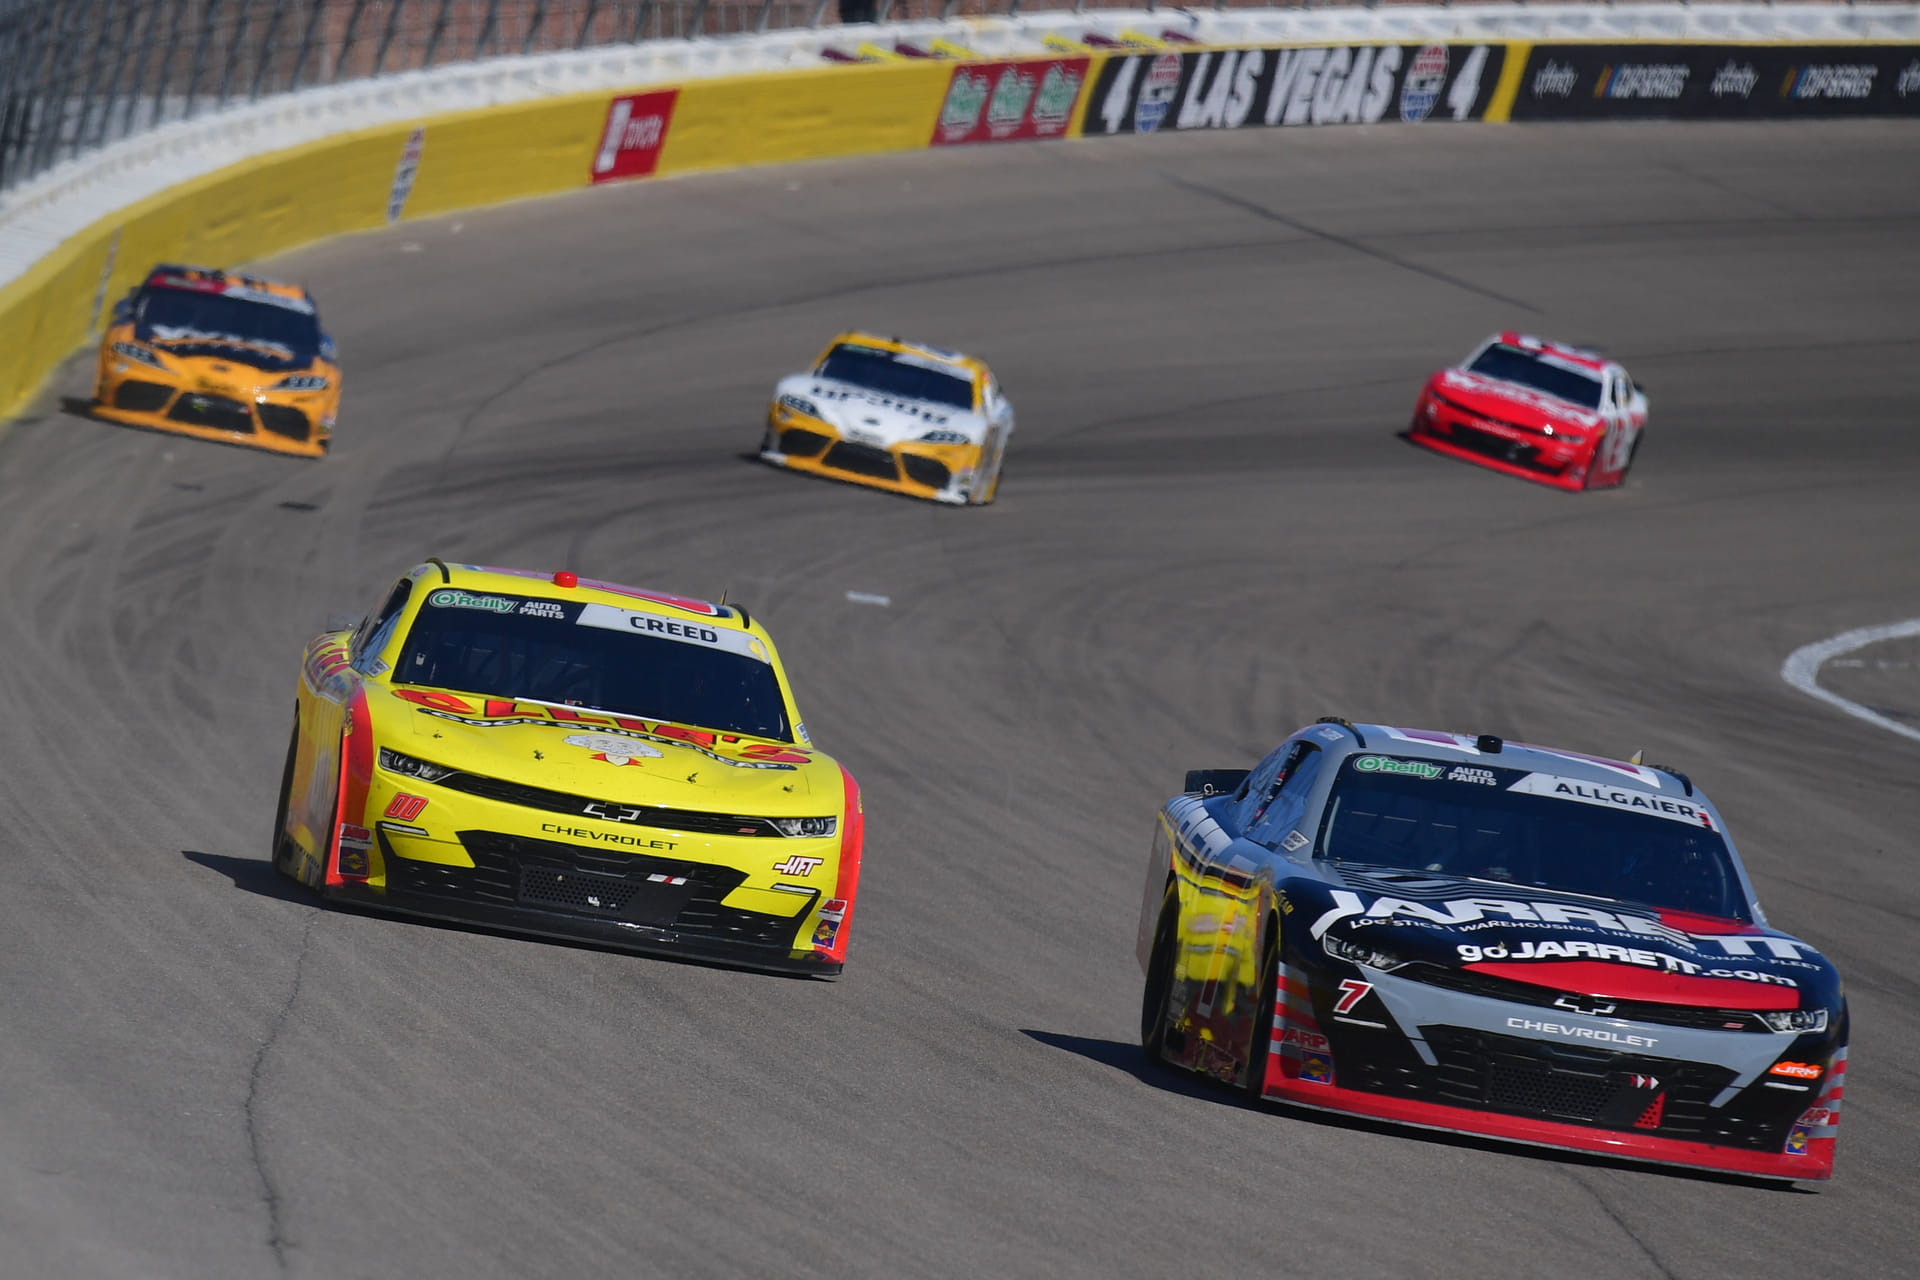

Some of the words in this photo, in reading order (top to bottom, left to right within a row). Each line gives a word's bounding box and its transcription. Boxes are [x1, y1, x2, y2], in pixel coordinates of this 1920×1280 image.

[1102, 55, 1140, 134] 4
[1177, 50, 1265, 129] LAS
[1265, 46, 1402, 126] VEGAS
[1447, 46, 1490, 122] 4
[432, 590, 514, 612] O'Reilly
[519, 607, 565, 619] PARTS
[525, 601, 562, 611] AUTO
[630, 616, 718, 643] CREED
[1356, 756, 1441, 777] O'Reilly
[1448, 772, 1497, 786] PARTS
[1454, 766, 1494, 778] AUTO
[384, 792, 429, 821] 00
[1555, 782, 1697, 819] ALLGAIER
[542, 824, 678, 850] CHEVROLET
[1310, 889, 1821, 959] JARRETT
[1350, 917, 1443, 931] LOGSTICS
[1459, 920, 1595, 933] WAREHOUSING
[1612, 931, 1753, 961] INTERNATIONAL
[1769, 959, 1823, 972] FLEET
[1457, 941, 1798, 987] goJARRETT.com
[1333, 978, 1374, 1015] 7
[1285, 1028, 1328, 1048] ARP
[1507, 1017, 1659, 1048] CHEVROLET
[1775, 1066, 1819, 1078] JRM
